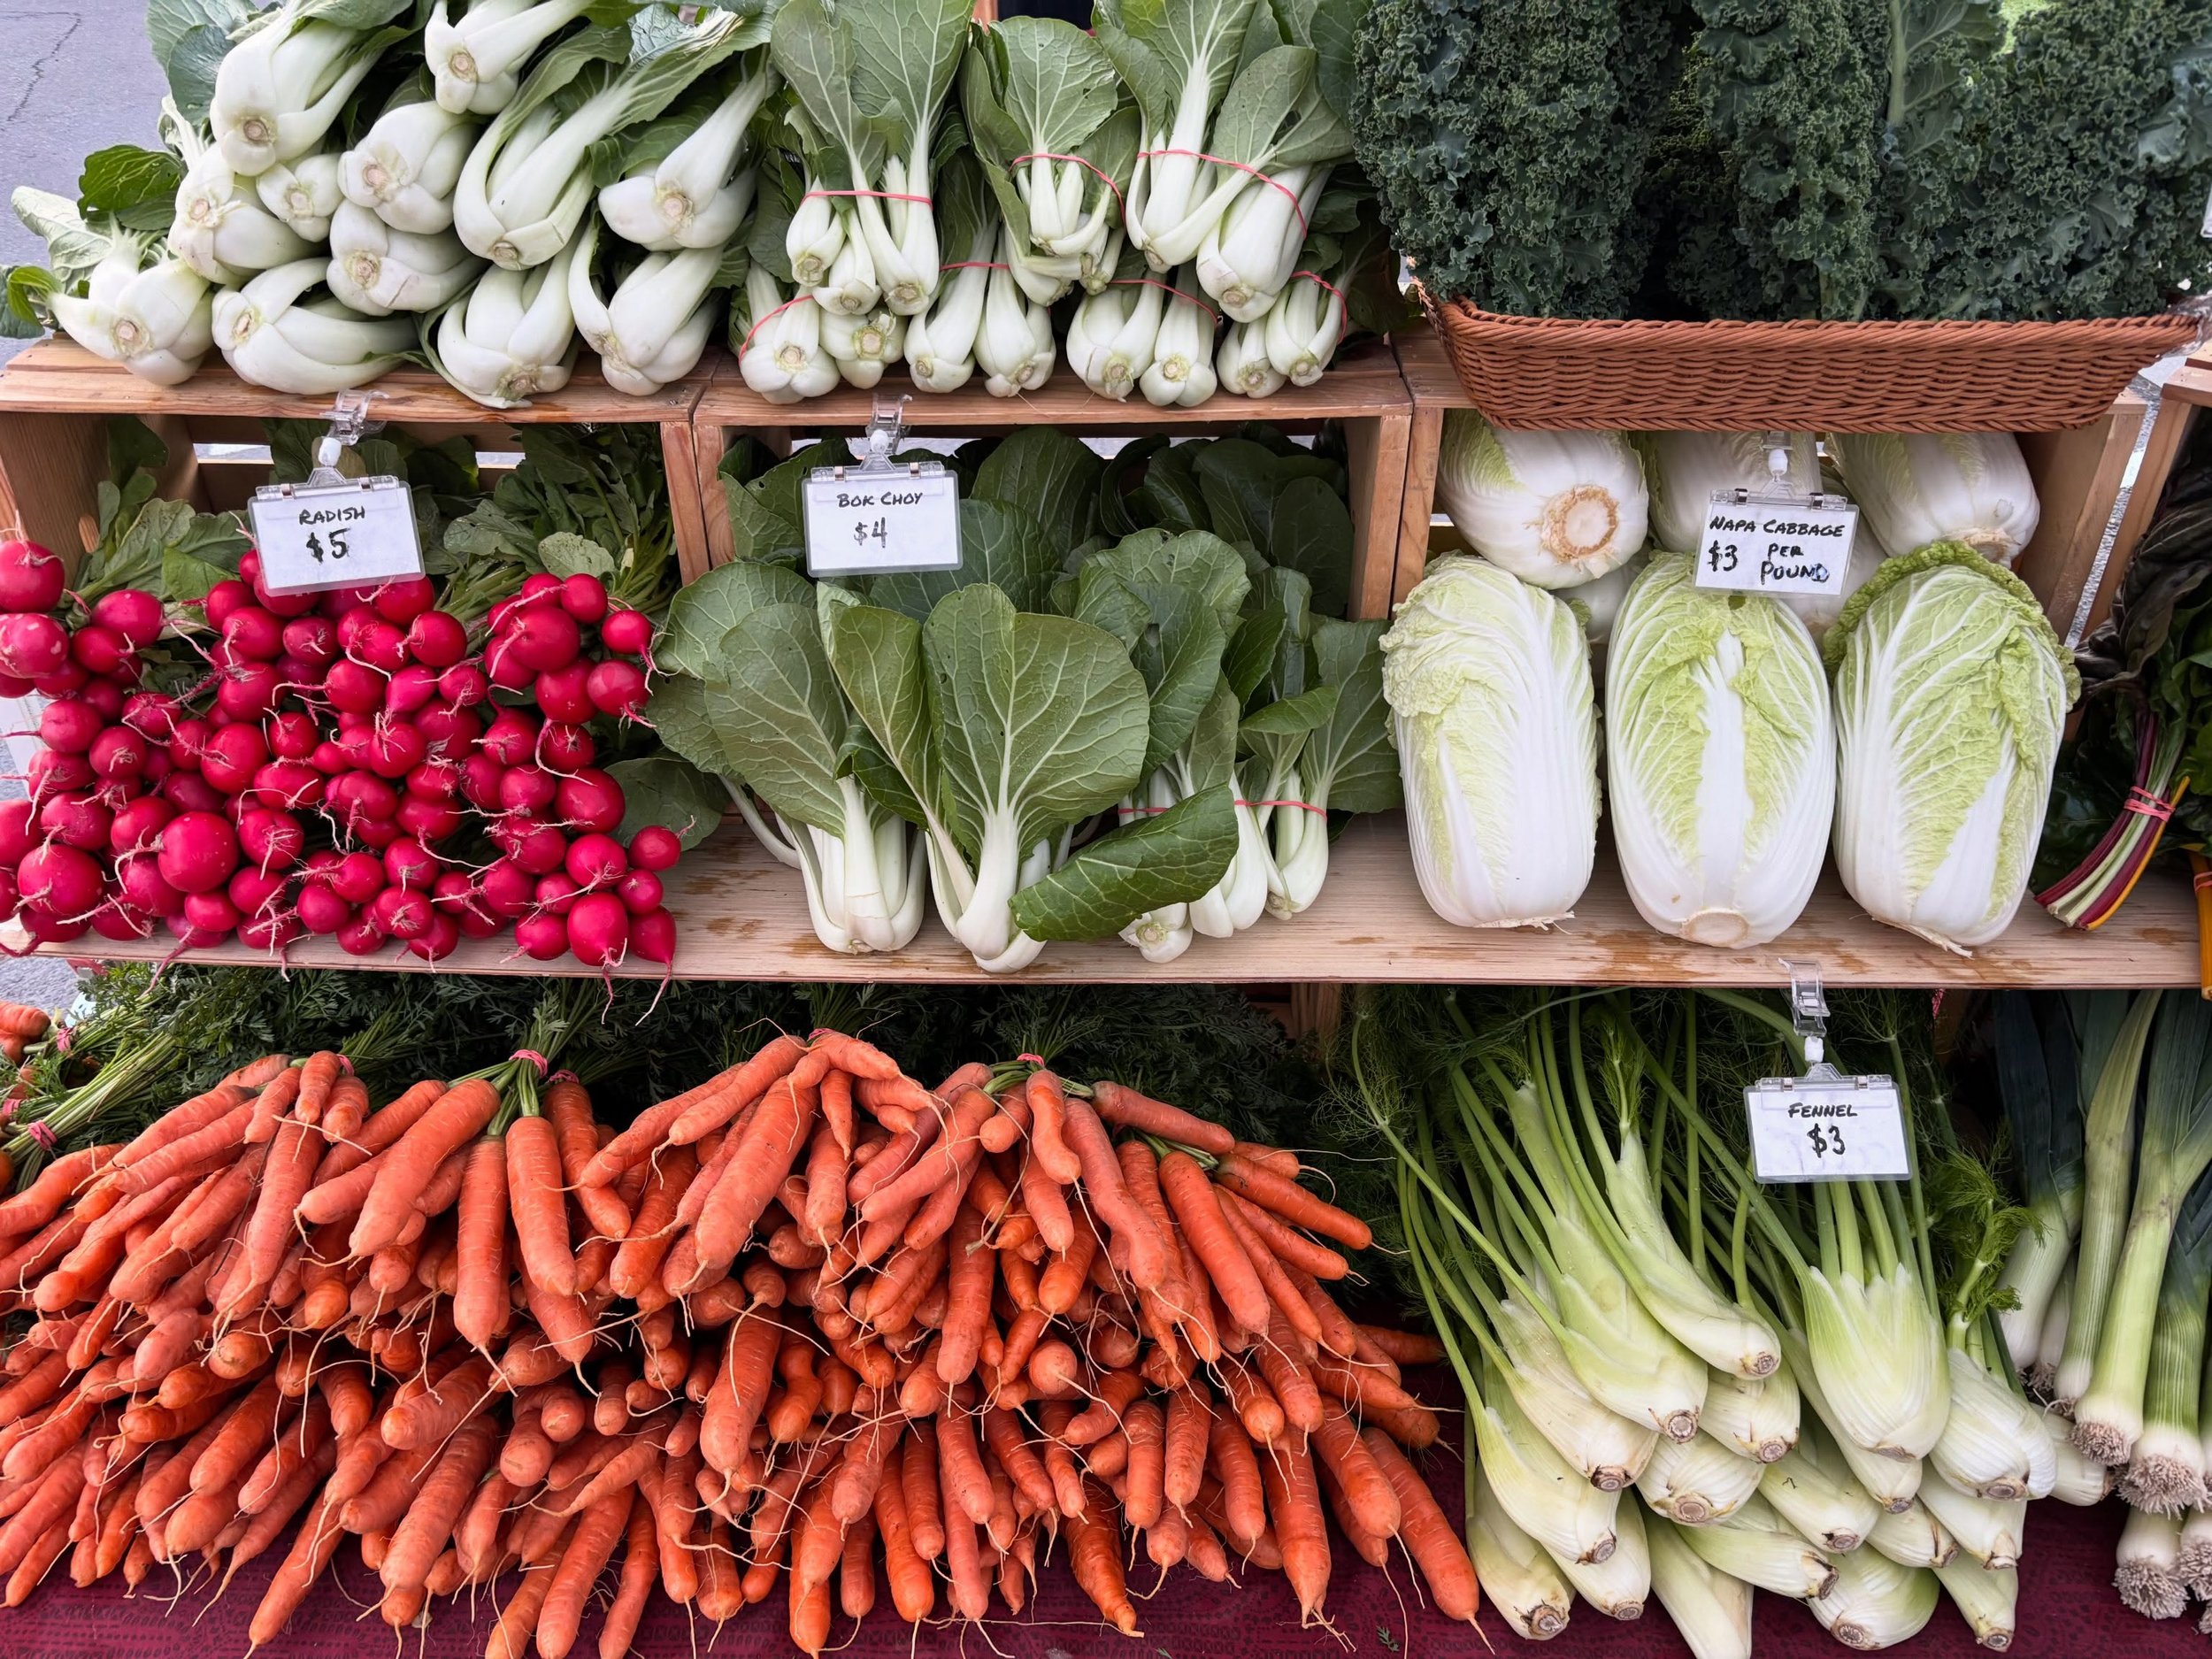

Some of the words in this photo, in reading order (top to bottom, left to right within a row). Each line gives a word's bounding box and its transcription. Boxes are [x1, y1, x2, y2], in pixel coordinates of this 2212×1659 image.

[837, 493, 874, 508] BOK
[880, 491, 923, 505] CHOY
[298, 506, 365, 526] RADISH
[1709, 516, 1755, 533] NAPA
[1763, 519, 1845, 537] CABBAGE
[854, 517, 887, 549] $4
[305, 527, 350, 565] $5
[1708, 540, 1738, 572] $3
[1768, 542, 1804, 560] PER
[1761, 560, 1830, 585] POUND
[1787, 1102, 1858, 1118] FENNEL
[1807, 1123, 1846, 1158] $3
